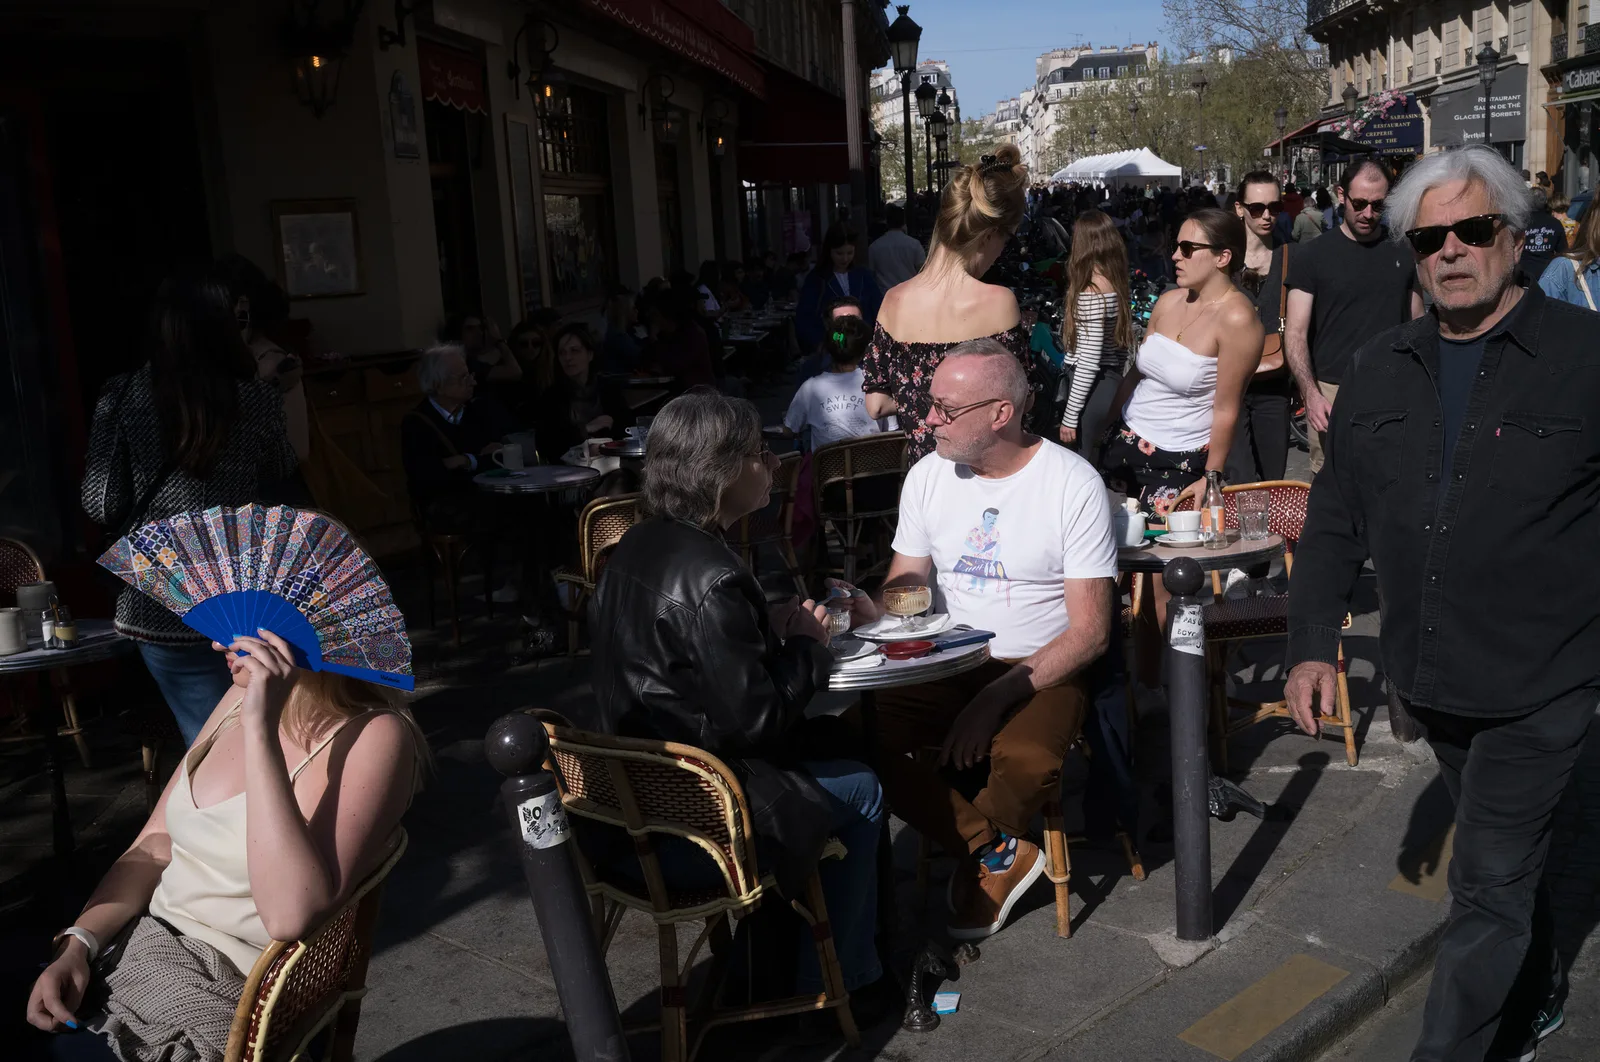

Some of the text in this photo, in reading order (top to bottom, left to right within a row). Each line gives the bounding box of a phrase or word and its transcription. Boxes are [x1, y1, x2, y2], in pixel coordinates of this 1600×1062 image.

[1491, 110, 1521, 118] SORBETS
[1373, 121, 1411, 129] RESTAURANT
[820, 394, 864, 409] TAYLOR
[826, 403, 859, 413] SWIFT
